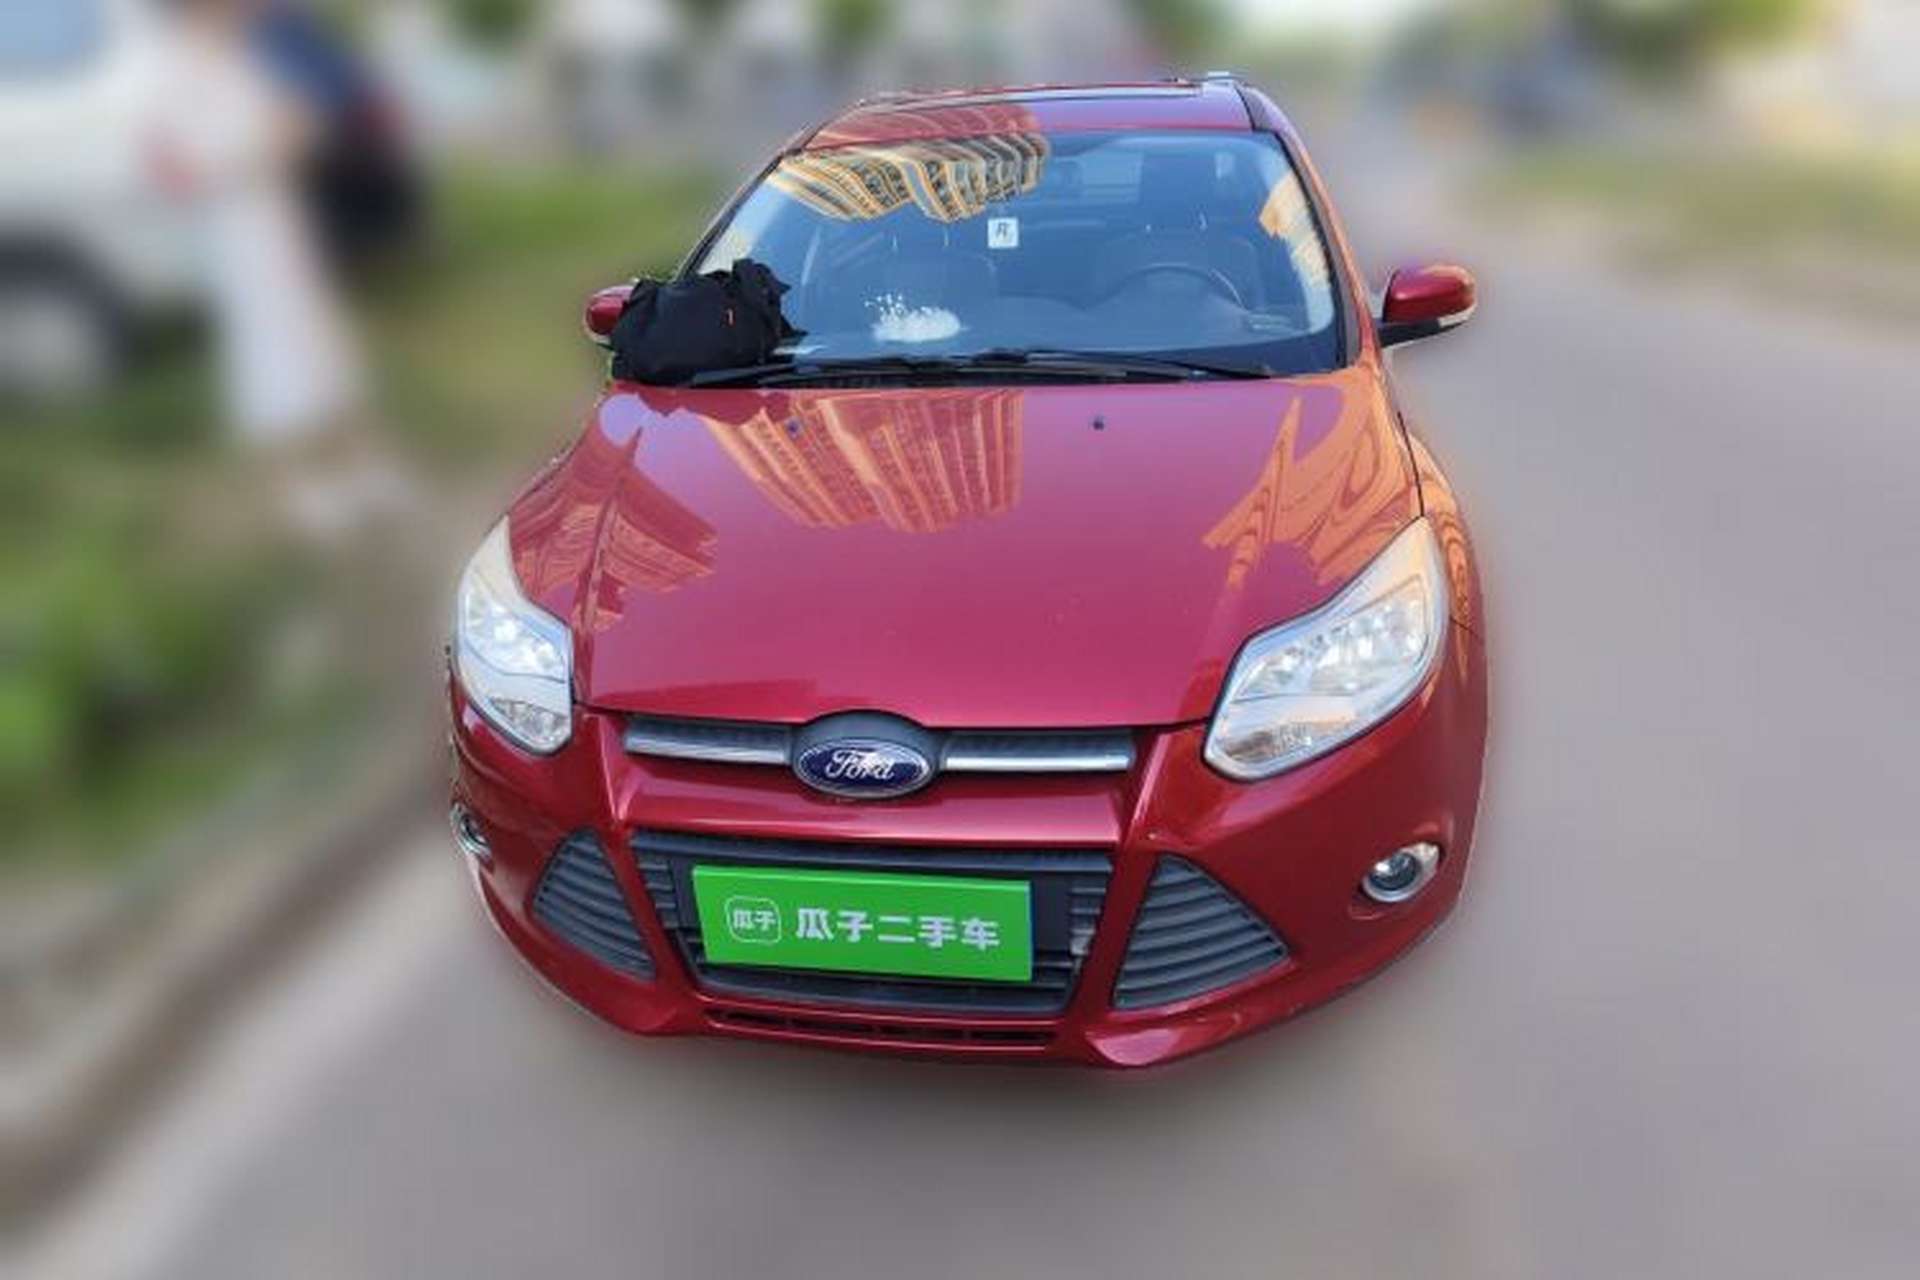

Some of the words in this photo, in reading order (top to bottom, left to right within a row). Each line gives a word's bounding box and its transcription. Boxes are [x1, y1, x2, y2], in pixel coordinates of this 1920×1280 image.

[825, 750, 895, 780] Ford
[732, 909, 777, 931] 瓜子
[796, 908, 1000, 949] 瓜子二手车
